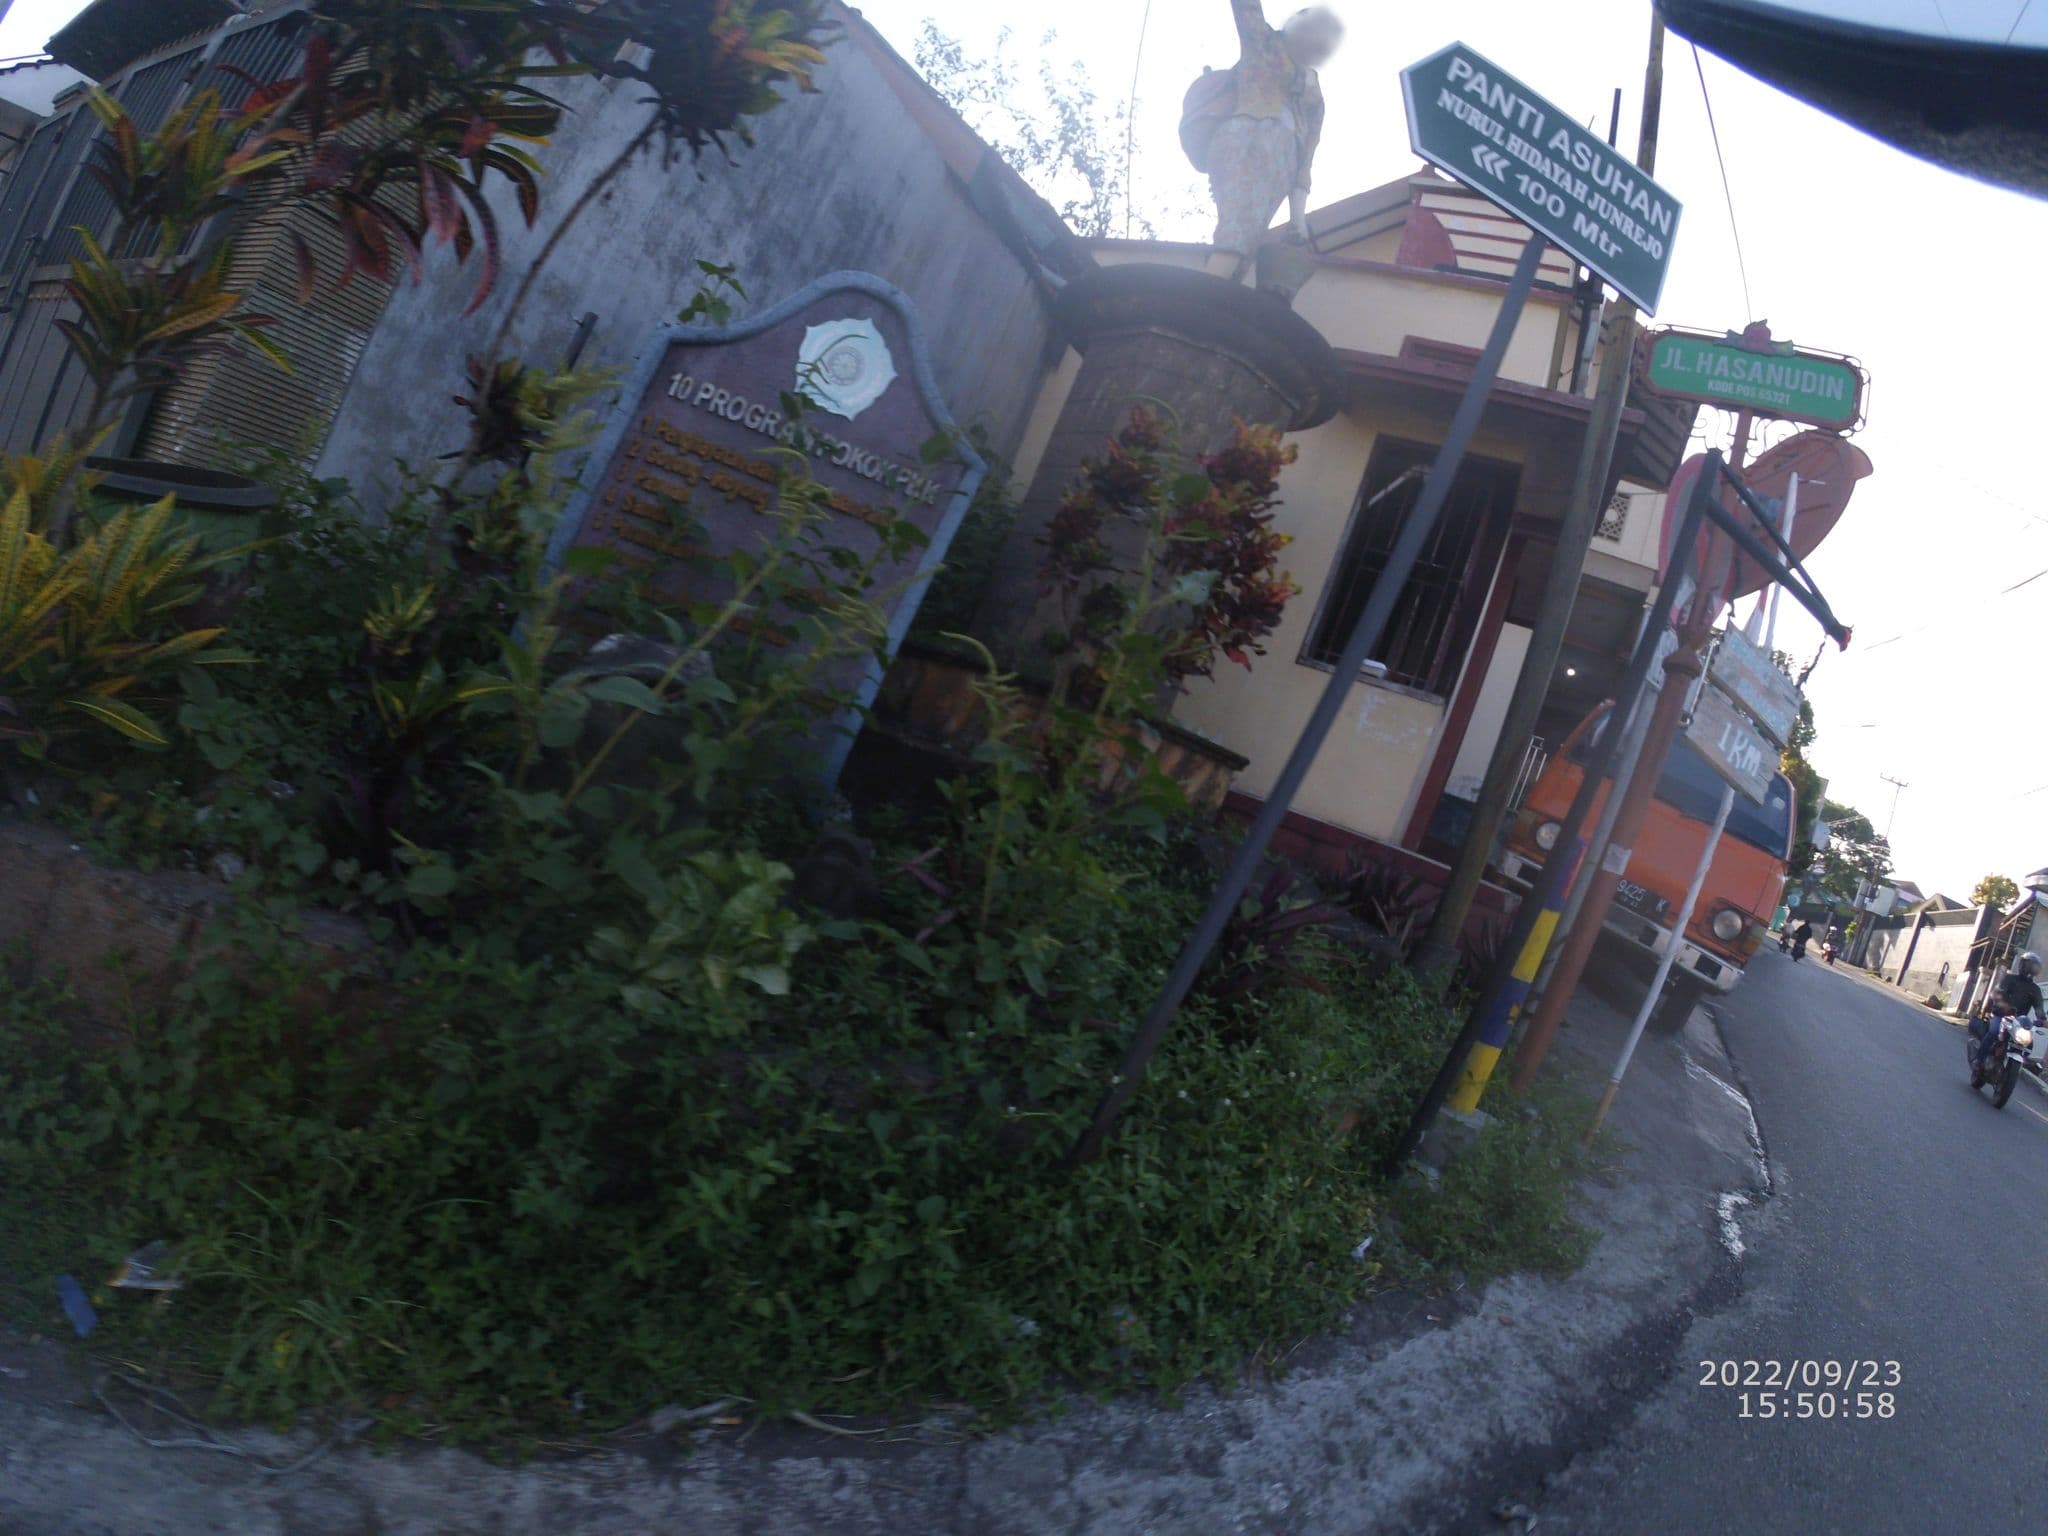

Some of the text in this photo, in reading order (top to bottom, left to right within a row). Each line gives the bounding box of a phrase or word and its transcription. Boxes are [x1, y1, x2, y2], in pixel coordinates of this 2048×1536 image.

[1436, 88, 1663, 260] NURUL HIDAYAH JUNREJO
[1446, 56, 1672, 236] PANTI ASUHAN
[1515, 172, 1624, 259] 100 Mtr
[668, 372, 694, 400] 10
[1660, 346, 1846, 402] JL. HASANUDIN
